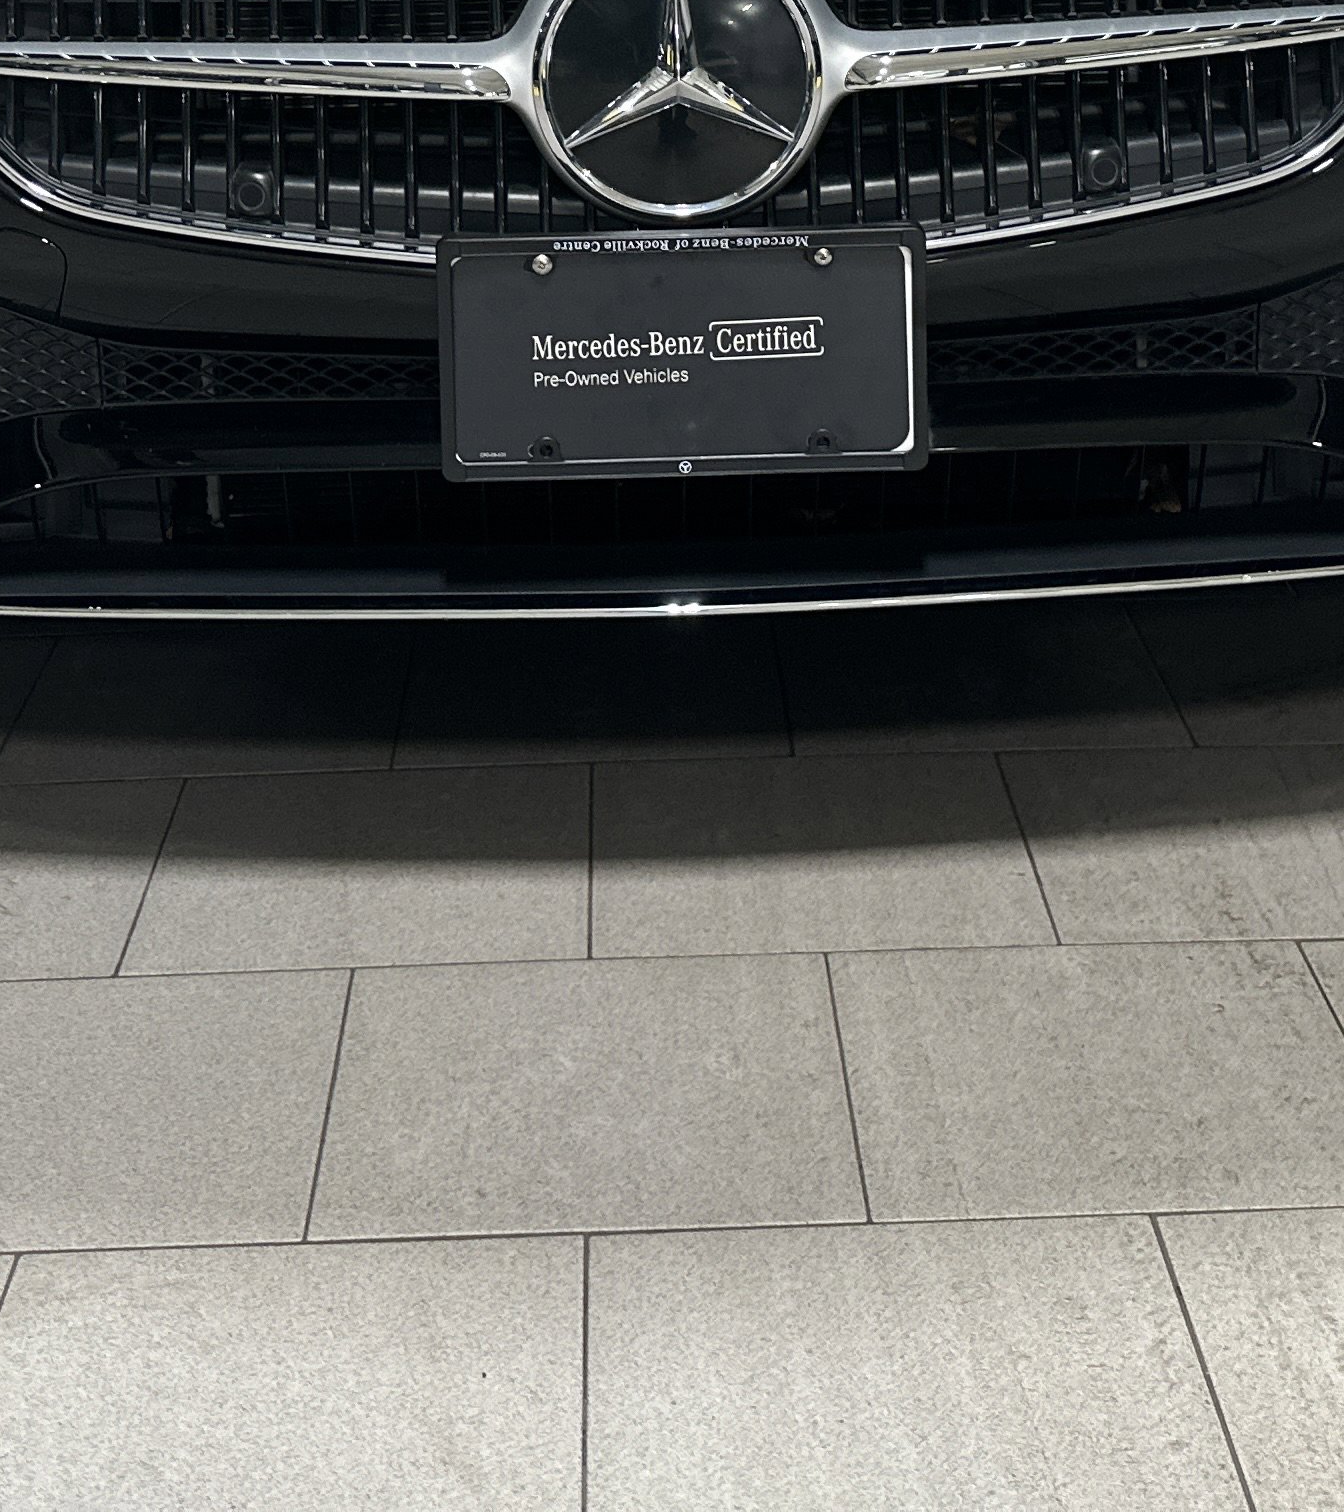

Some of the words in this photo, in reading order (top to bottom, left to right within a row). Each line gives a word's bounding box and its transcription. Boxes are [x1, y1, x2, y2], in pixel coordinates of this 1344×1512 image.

[553, 241, 601, 253] Centre
[603, 240, 669, 252] Rockville
[674, 239, 689, 251] of
[692, 236, 809, 249] Mercedes-Benz
[532, 331, 704, 360] Mercedes-Benz
[716, 324, 816, 353] Certified
[534, 370, 619, 387] Pre-Owned
[624, 368, 689, 384] Vehicles
